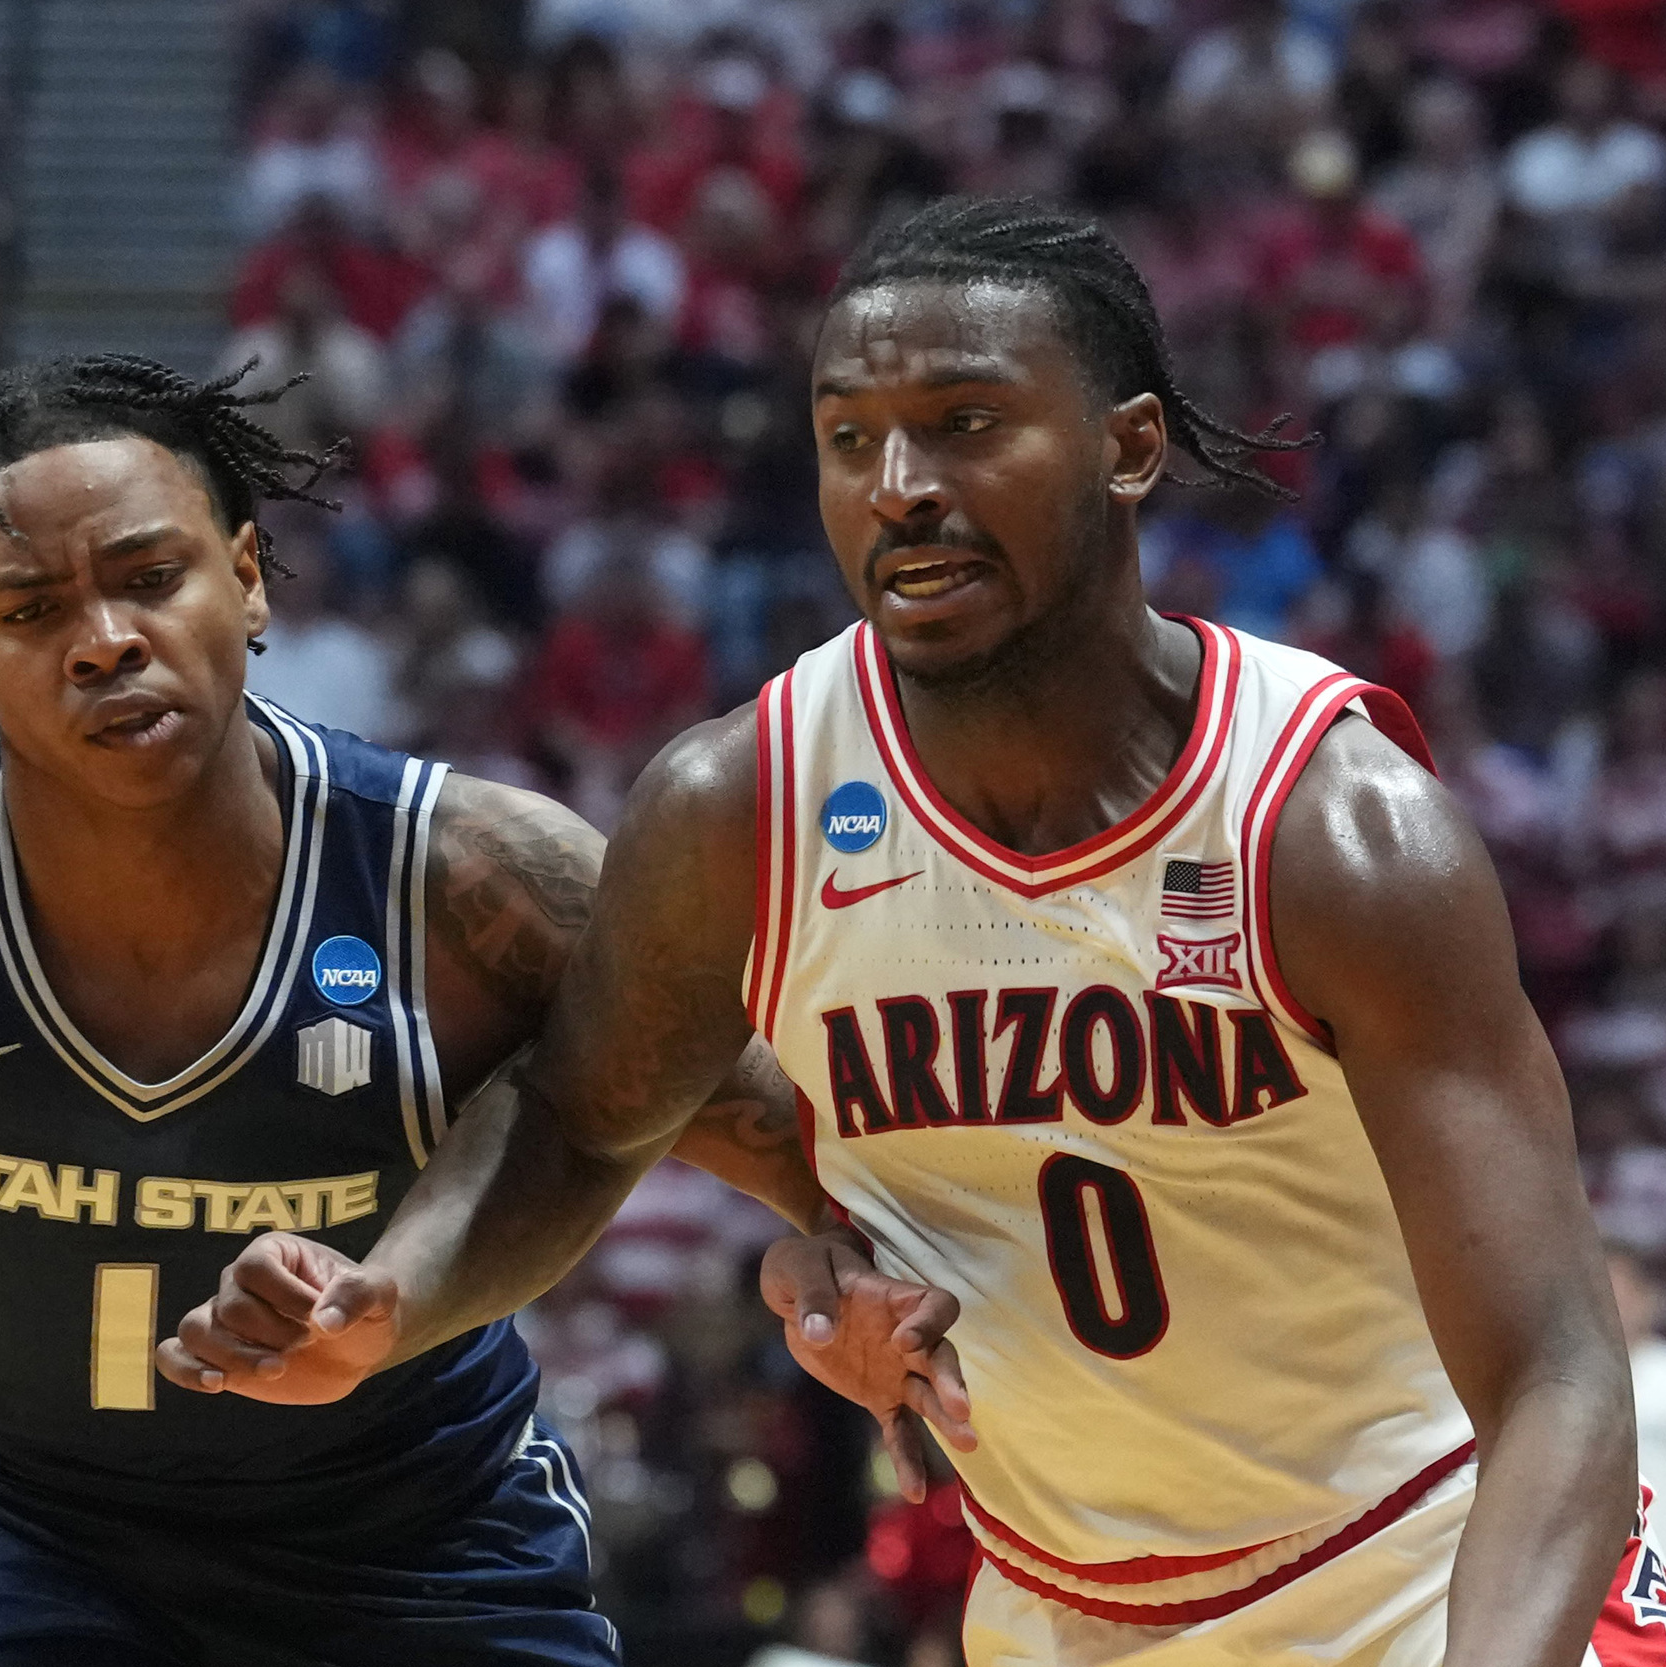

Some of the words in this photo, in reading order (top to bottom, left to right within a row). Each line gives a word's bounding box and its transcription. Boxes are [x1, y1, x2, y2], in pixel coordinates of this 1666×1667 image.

[828, 815, 881, 835] NCAA
[321, 968, 378, 988] NCAA
[1161, 939, 1235, 982] XII
[821, 984, 1309, 1139] ARIZONA
[134, 1169, 380, 1233] STATE
[1037, 1150, 1170, 1361] 0
[90, 1261, 160, 1412] 1
